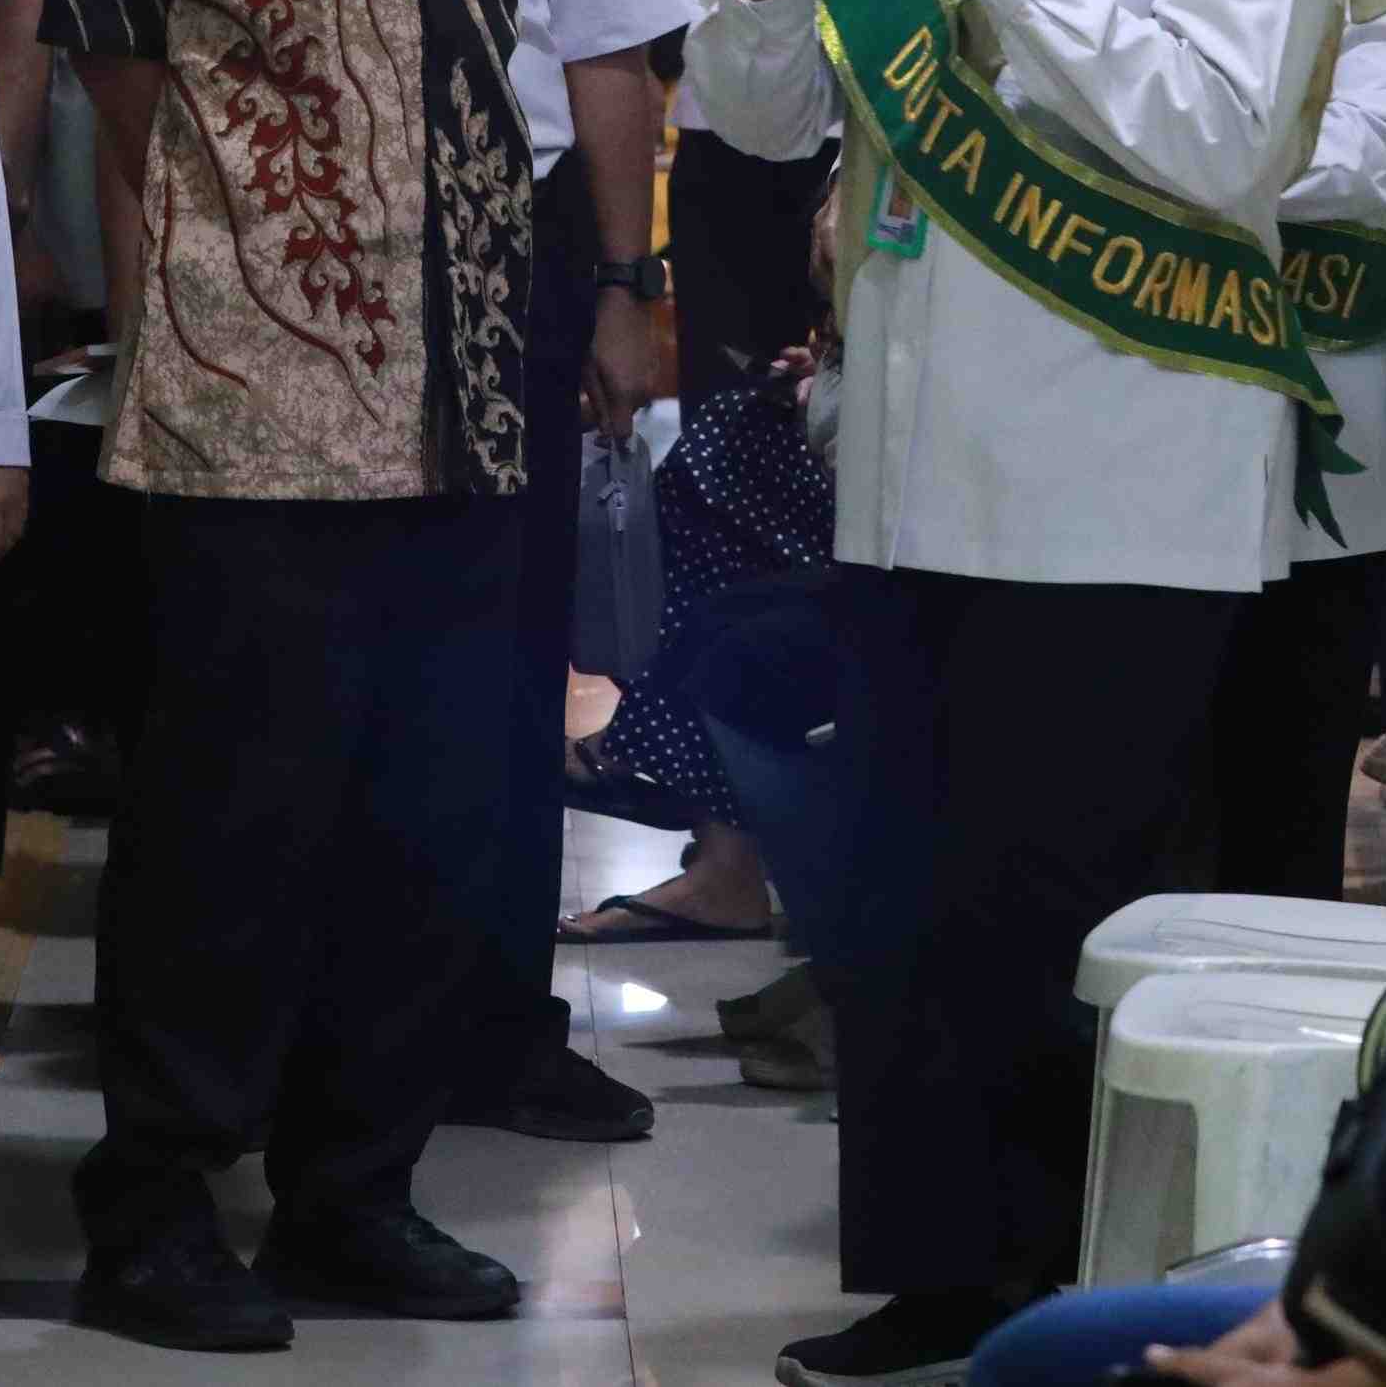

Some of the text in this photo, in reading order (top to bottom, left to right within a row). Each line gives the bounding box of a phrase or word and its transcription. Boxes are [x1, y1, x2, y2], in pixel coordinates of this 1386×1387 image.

[883, 25, 1288, 349] DUTA INFORMASI
[1281, 248, 1366, 318] ASI
